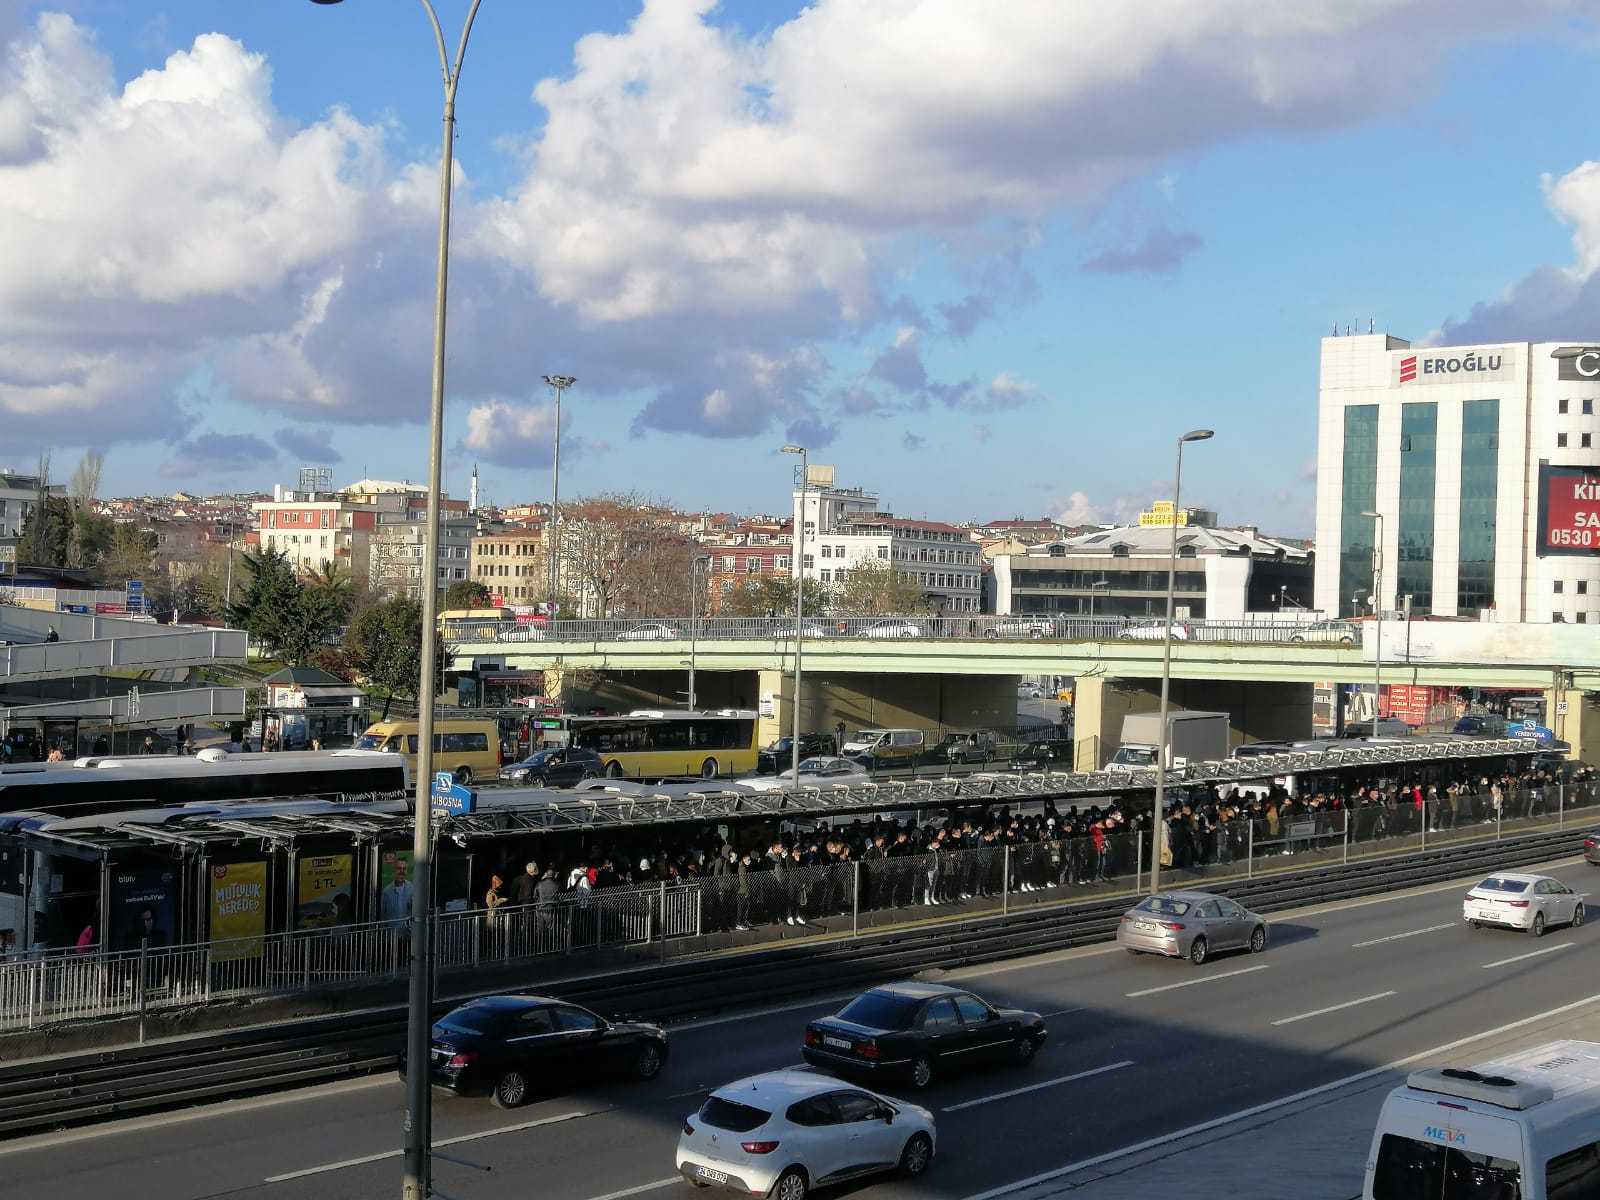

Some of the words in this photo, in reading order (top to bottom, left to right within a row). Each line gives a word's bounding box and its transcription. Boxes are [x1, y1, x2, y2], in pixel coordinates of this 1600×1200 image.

[1423, 352, 1502, 374] EROĞLU
[1551, 529, 1592, 546] 0530
[314, 879, 321, 889] 1
[323, 878, 337, 889] TL
[215, 883, 261, 903] MUTLULUK
[219, 898, 260, 916] NEREDE?
[1424, 1126, 1465, 1143] MEVA
